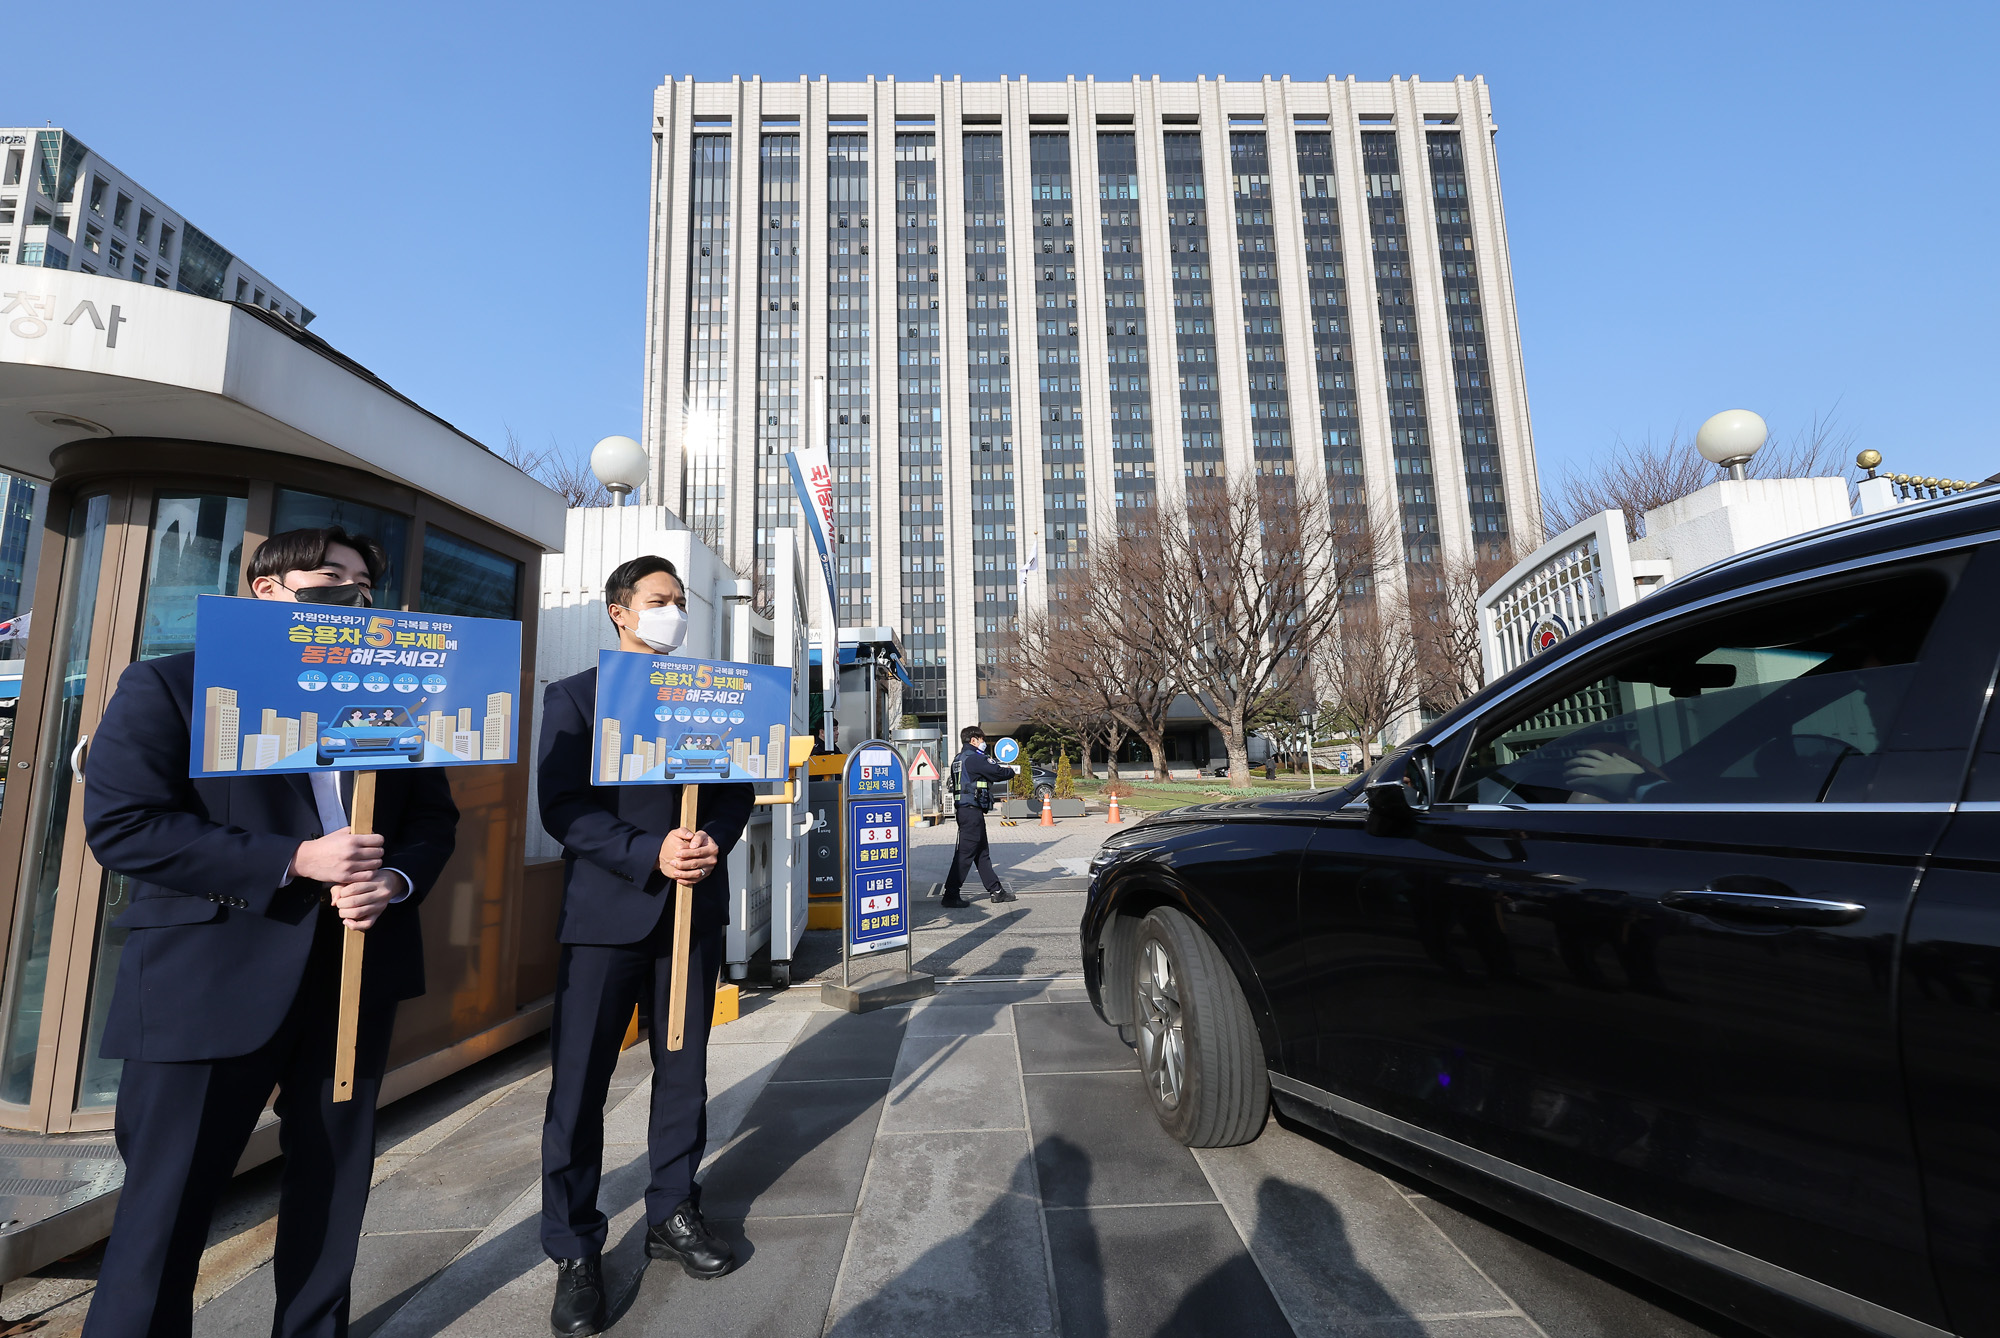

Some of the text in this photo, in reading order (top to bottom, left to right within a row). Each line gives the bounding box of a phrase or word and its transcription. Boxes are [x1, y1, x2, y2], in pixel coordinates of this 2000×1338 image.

[292, 612, 365, 625] 자원안보위기
[432, 622, 453, 632] 위한
[289, 624, 363, 645] 승용차
[301, 645, 447, 668] 동참해주세요!
[652, 661, 696, 672] 자원안보위기
[735, 668, 749, 676] 위한
[650, 671, 694, 687] 승용차
[656, 687, 745, 705] 동참해주세요!
[863, 767, 889, 778] 5 부제
[858, 780, 896, 791] 요일제 적용
[865, 811, 892, 824] 오늘은
[885, 829, 892, 840] 8
[860, 847, 899, 862] 출입제한
[866, 878, 893, 891] 내일은
[885, 896, 892, 907] 9
[861, 914, 900, 931] 출입제한
